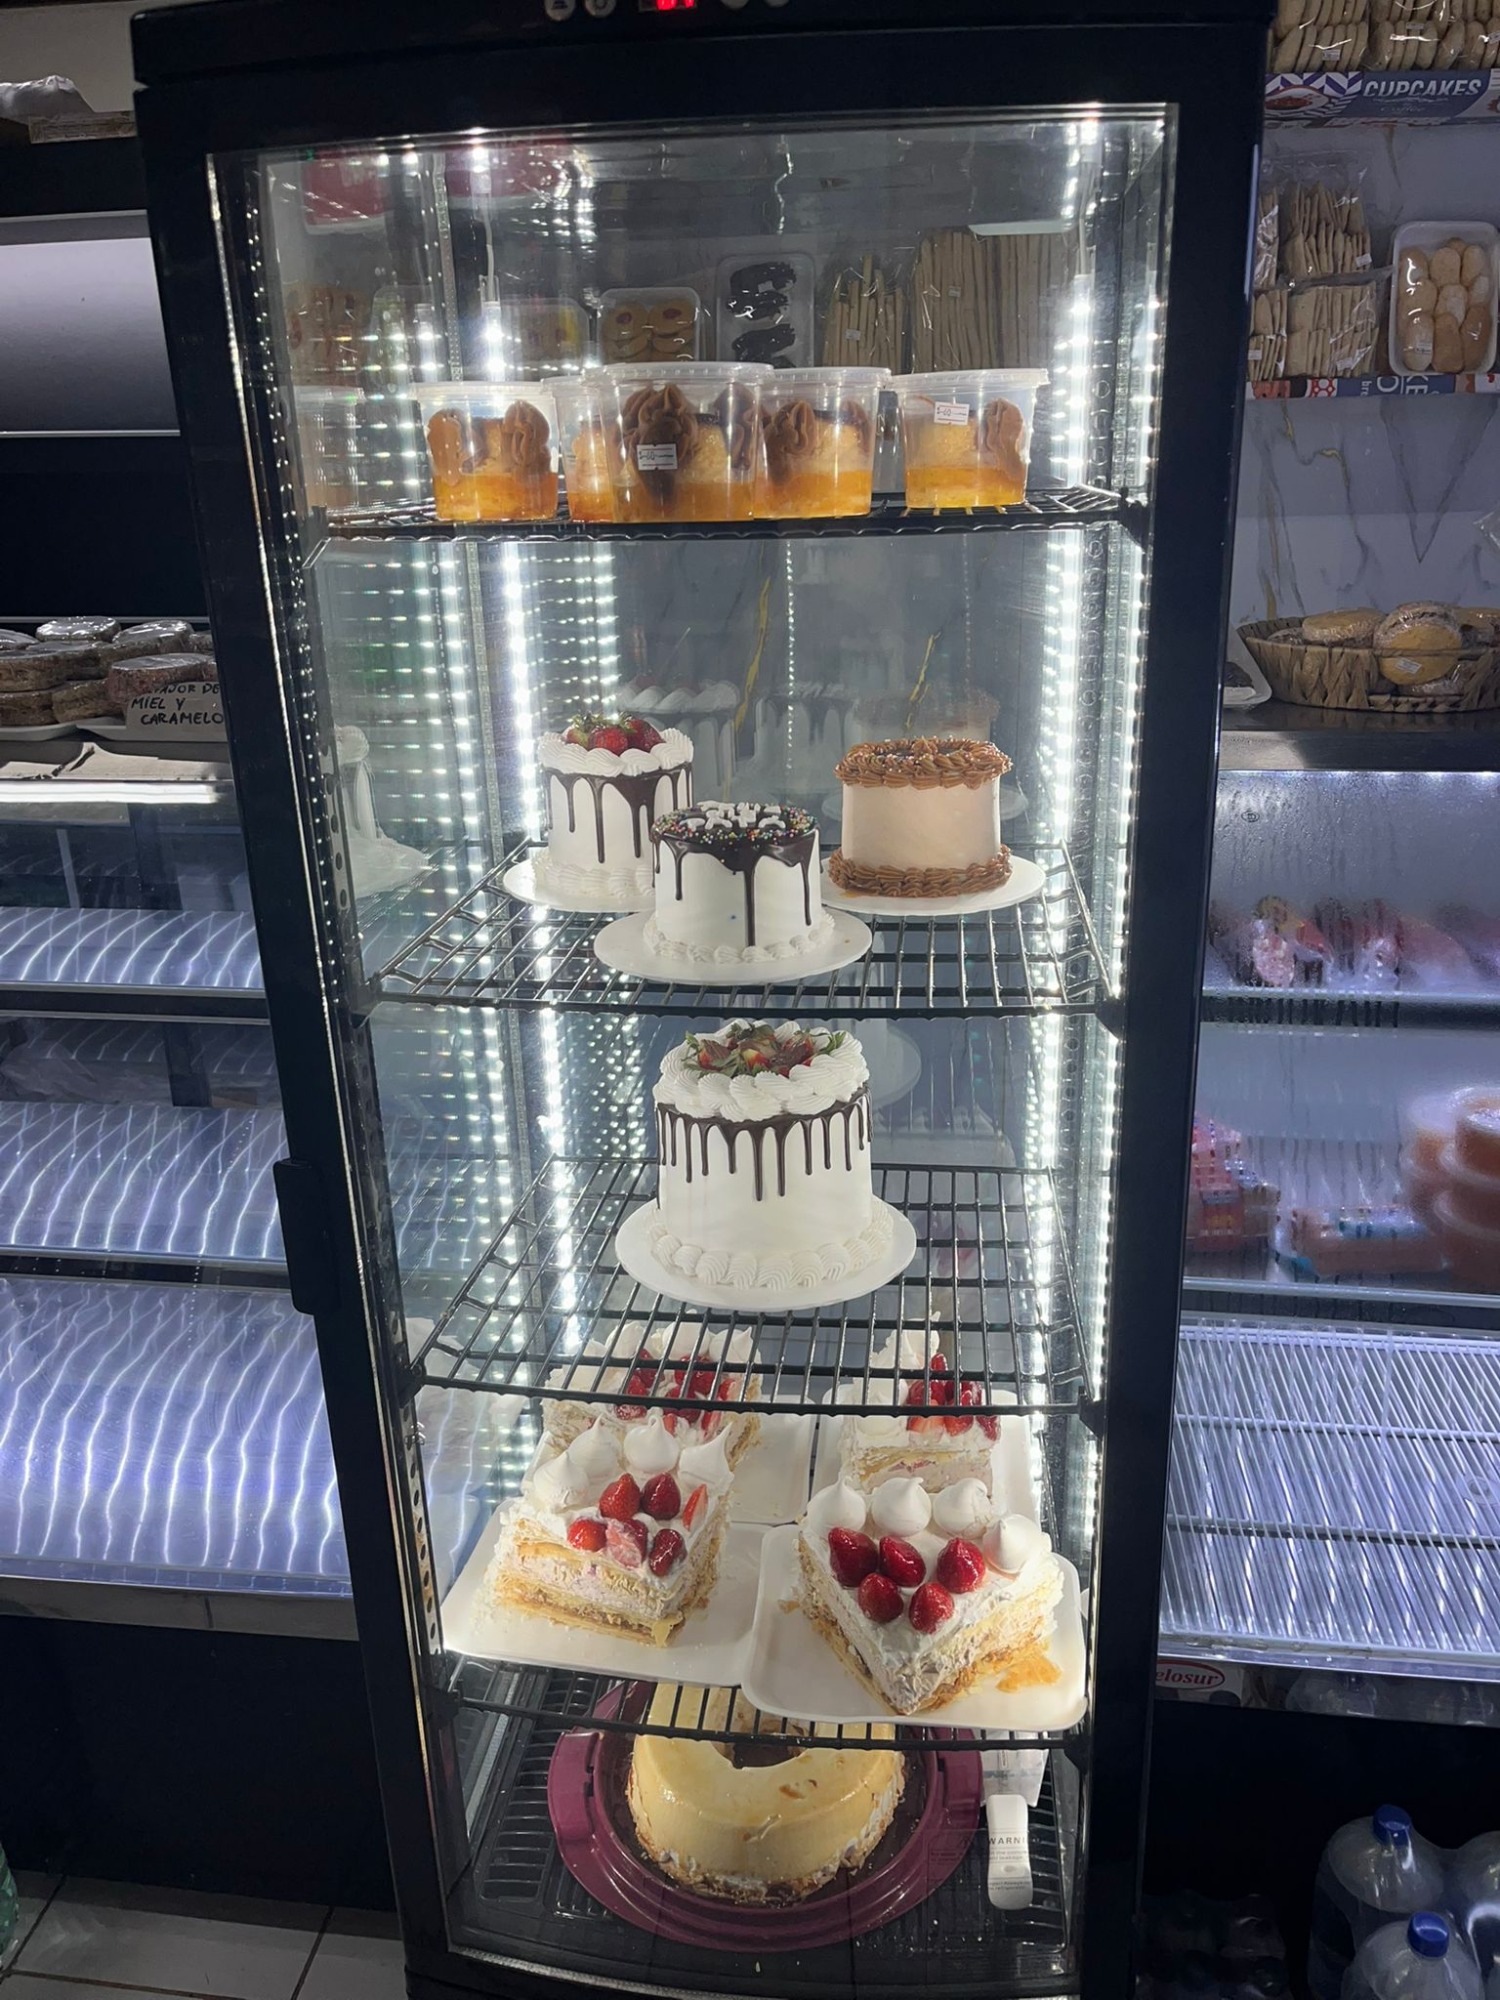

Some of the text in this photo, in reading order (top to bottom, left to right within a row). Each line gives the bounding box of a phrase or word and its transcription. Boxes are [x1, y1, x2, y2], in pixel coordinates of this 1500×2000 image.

[1363, 79, 1482, 97] CUPCAKES
[131, 697, 187, 711] MIEL Y
[140, 712, 224, 725] CARAMELO
[1155, 1668, 1219, 1685] elosur
